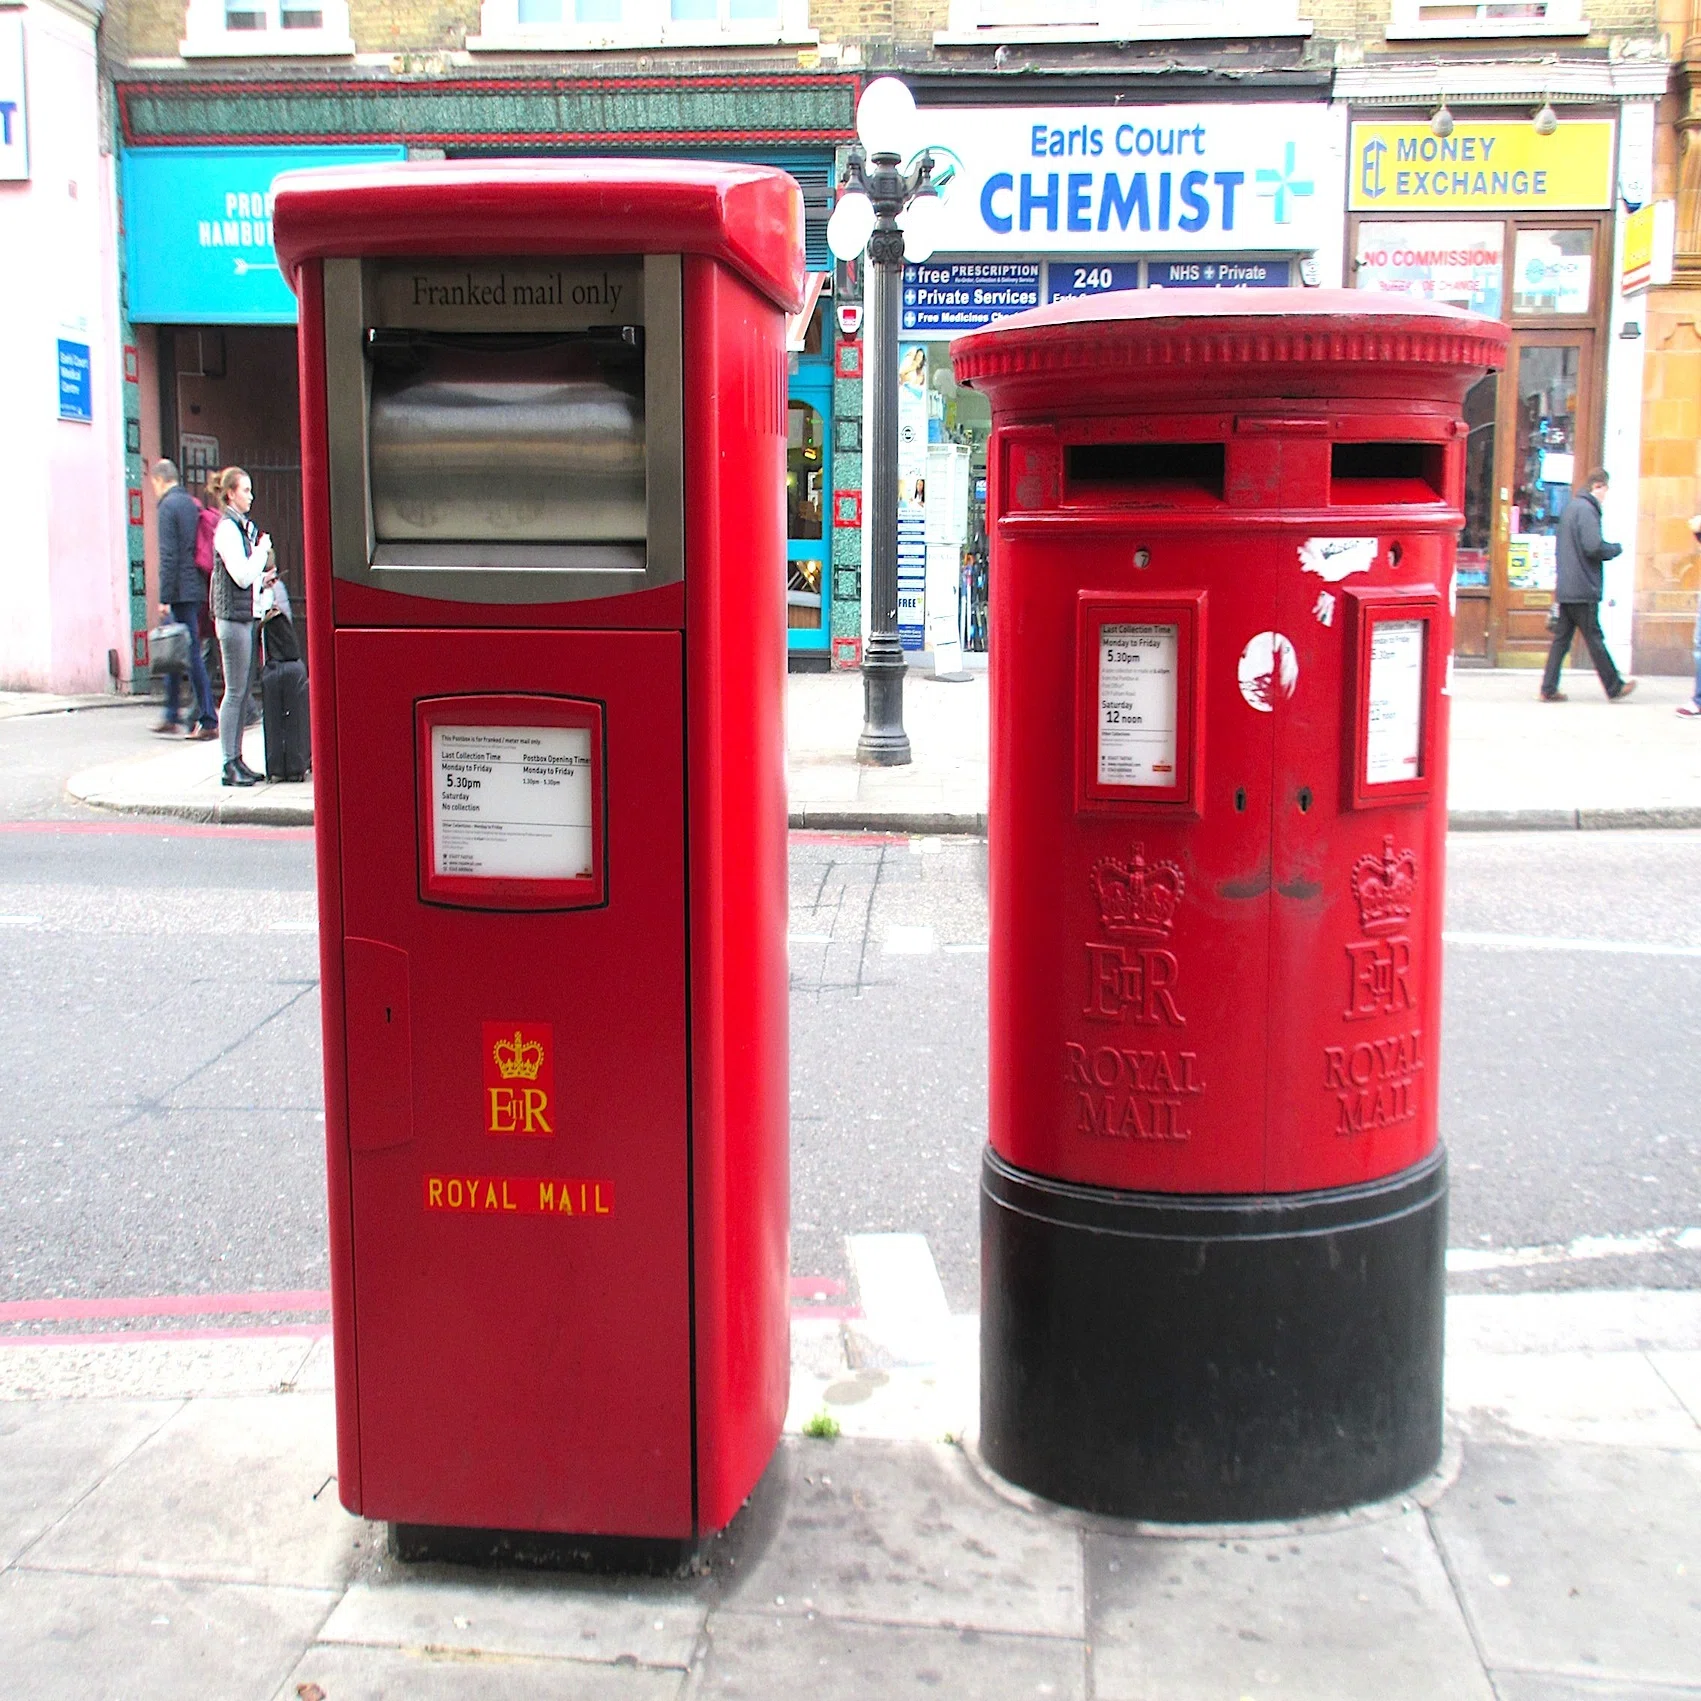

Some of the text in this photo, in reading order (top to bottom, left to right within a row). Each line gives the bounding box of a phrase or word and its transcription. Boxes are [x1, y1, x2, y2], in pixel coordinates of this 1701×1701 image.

[1031, 123, 1206, 156] Earls Court
[1396, 137, 1496, 162] MONEY
[1396, 171, 1548, 195] EXCHANGE
[980, 170, 1244, 233] CHEMIST
[1364, 249, 1498, 267] NO COMMISSION
[918, 265, 1039, 284] free PRESCRIPTION
[1073, 267, 1112, 288] 240
[1169, 265, 1266, 280] NHS Private
[411, 272, 623, 313] Franked mail only
[918, 288, 1037, 305] Private Services
[918, 311, 939, 323] Free
[941, 310, 990, 323] Medicines
[898, 598, 916, 608] FREE
[1103, 625, 1171, 634] Last Collection Time
[1103, 638, 1129, 648] Monday
[1139, 638, 1161, 648] Friday
[1107, 649, 1140, 664] 5.30pm
[1102, 701, 1133, 711] Saturday
[1106, 711, 1143, 724] 12 noon
[456, 752, 485, 760] Collection
[486, 752, 501, 760] Time
[523, 754, 547, 762] Postbox
[548, 755, 573, 764] Opening
[441, 763, 492, 773] Monday to Friday
[523, 766, 547, 775] Monday
[555, 767, 574, 776] Friday
[446, 774, 481, 789] 5.30pm
[442, 792, 469, 801] Saturday
[442, 803, 480, 812] No collection
[1065, 1041, 1207, 1093] ROYAL
[1324, 1029, 1424, 1090] ROYAL
[1336, 1076, 1417, 1138] MAIL
[1077, 1091, 1192, 1140] MAIL
[429, 1178, 609, 1213] ROYAL MAIL
